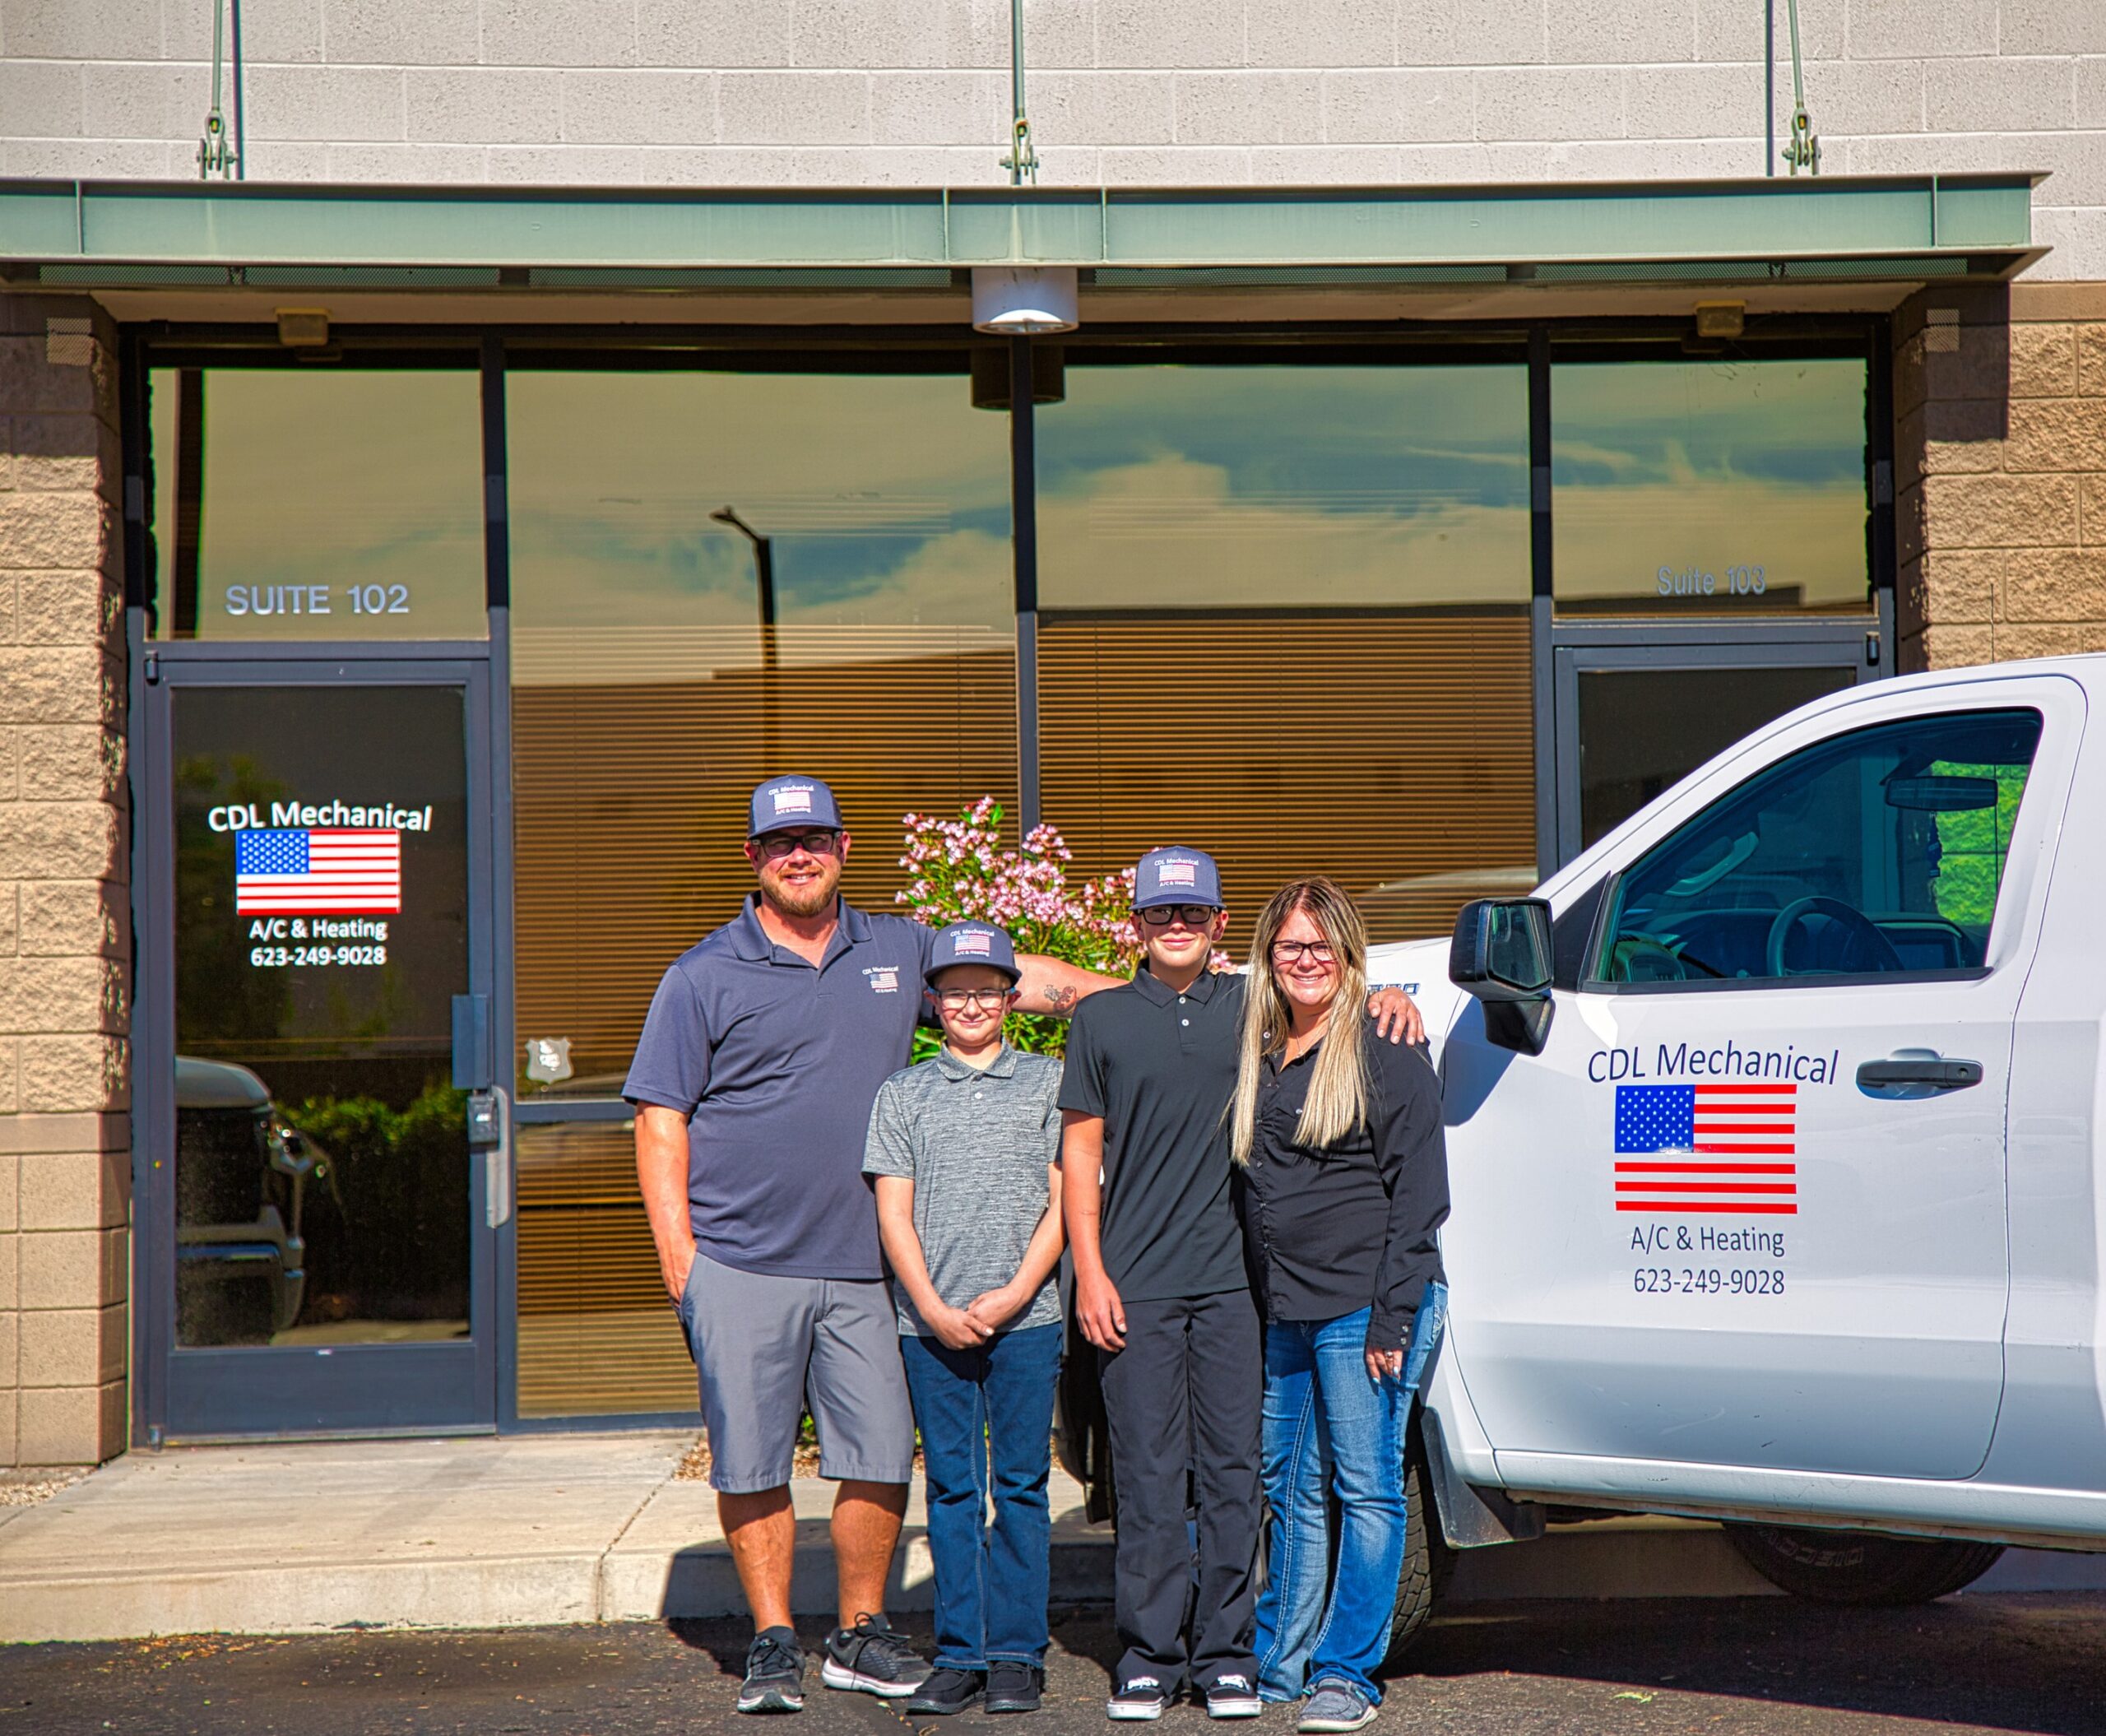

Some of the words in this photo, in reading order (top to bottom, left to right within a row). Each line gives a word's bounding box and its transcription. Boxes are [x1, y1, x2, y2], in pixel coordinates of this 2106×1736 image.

[1657, 565, 1716, 596] Suite
[1724, 564, 1767, 596] 103
[225, 584, 332, 615] SUITE
[346, 583, 411, 615] 102
[207, 803, 267, 833] CDL
[271, 799, 434, 833] Mechanical
[249, 918, 288, 942] A/C
[290, 919, 308, 939] &
[312, 918, 388, 942] Heating
[249, 945, 388, 967] 623-249-9028
[1587, 1046, 1647, 1084] CDL
[1656, 1039, 1839, 1085] Mechanical
[1631, 1223, 1671, 1255] A/C
[1676, 1225, 1694, 1251] &
[1700, 1227, 1786, 1258] Heating
[1634, 1268, 1786, 1295] 623-249-9028
